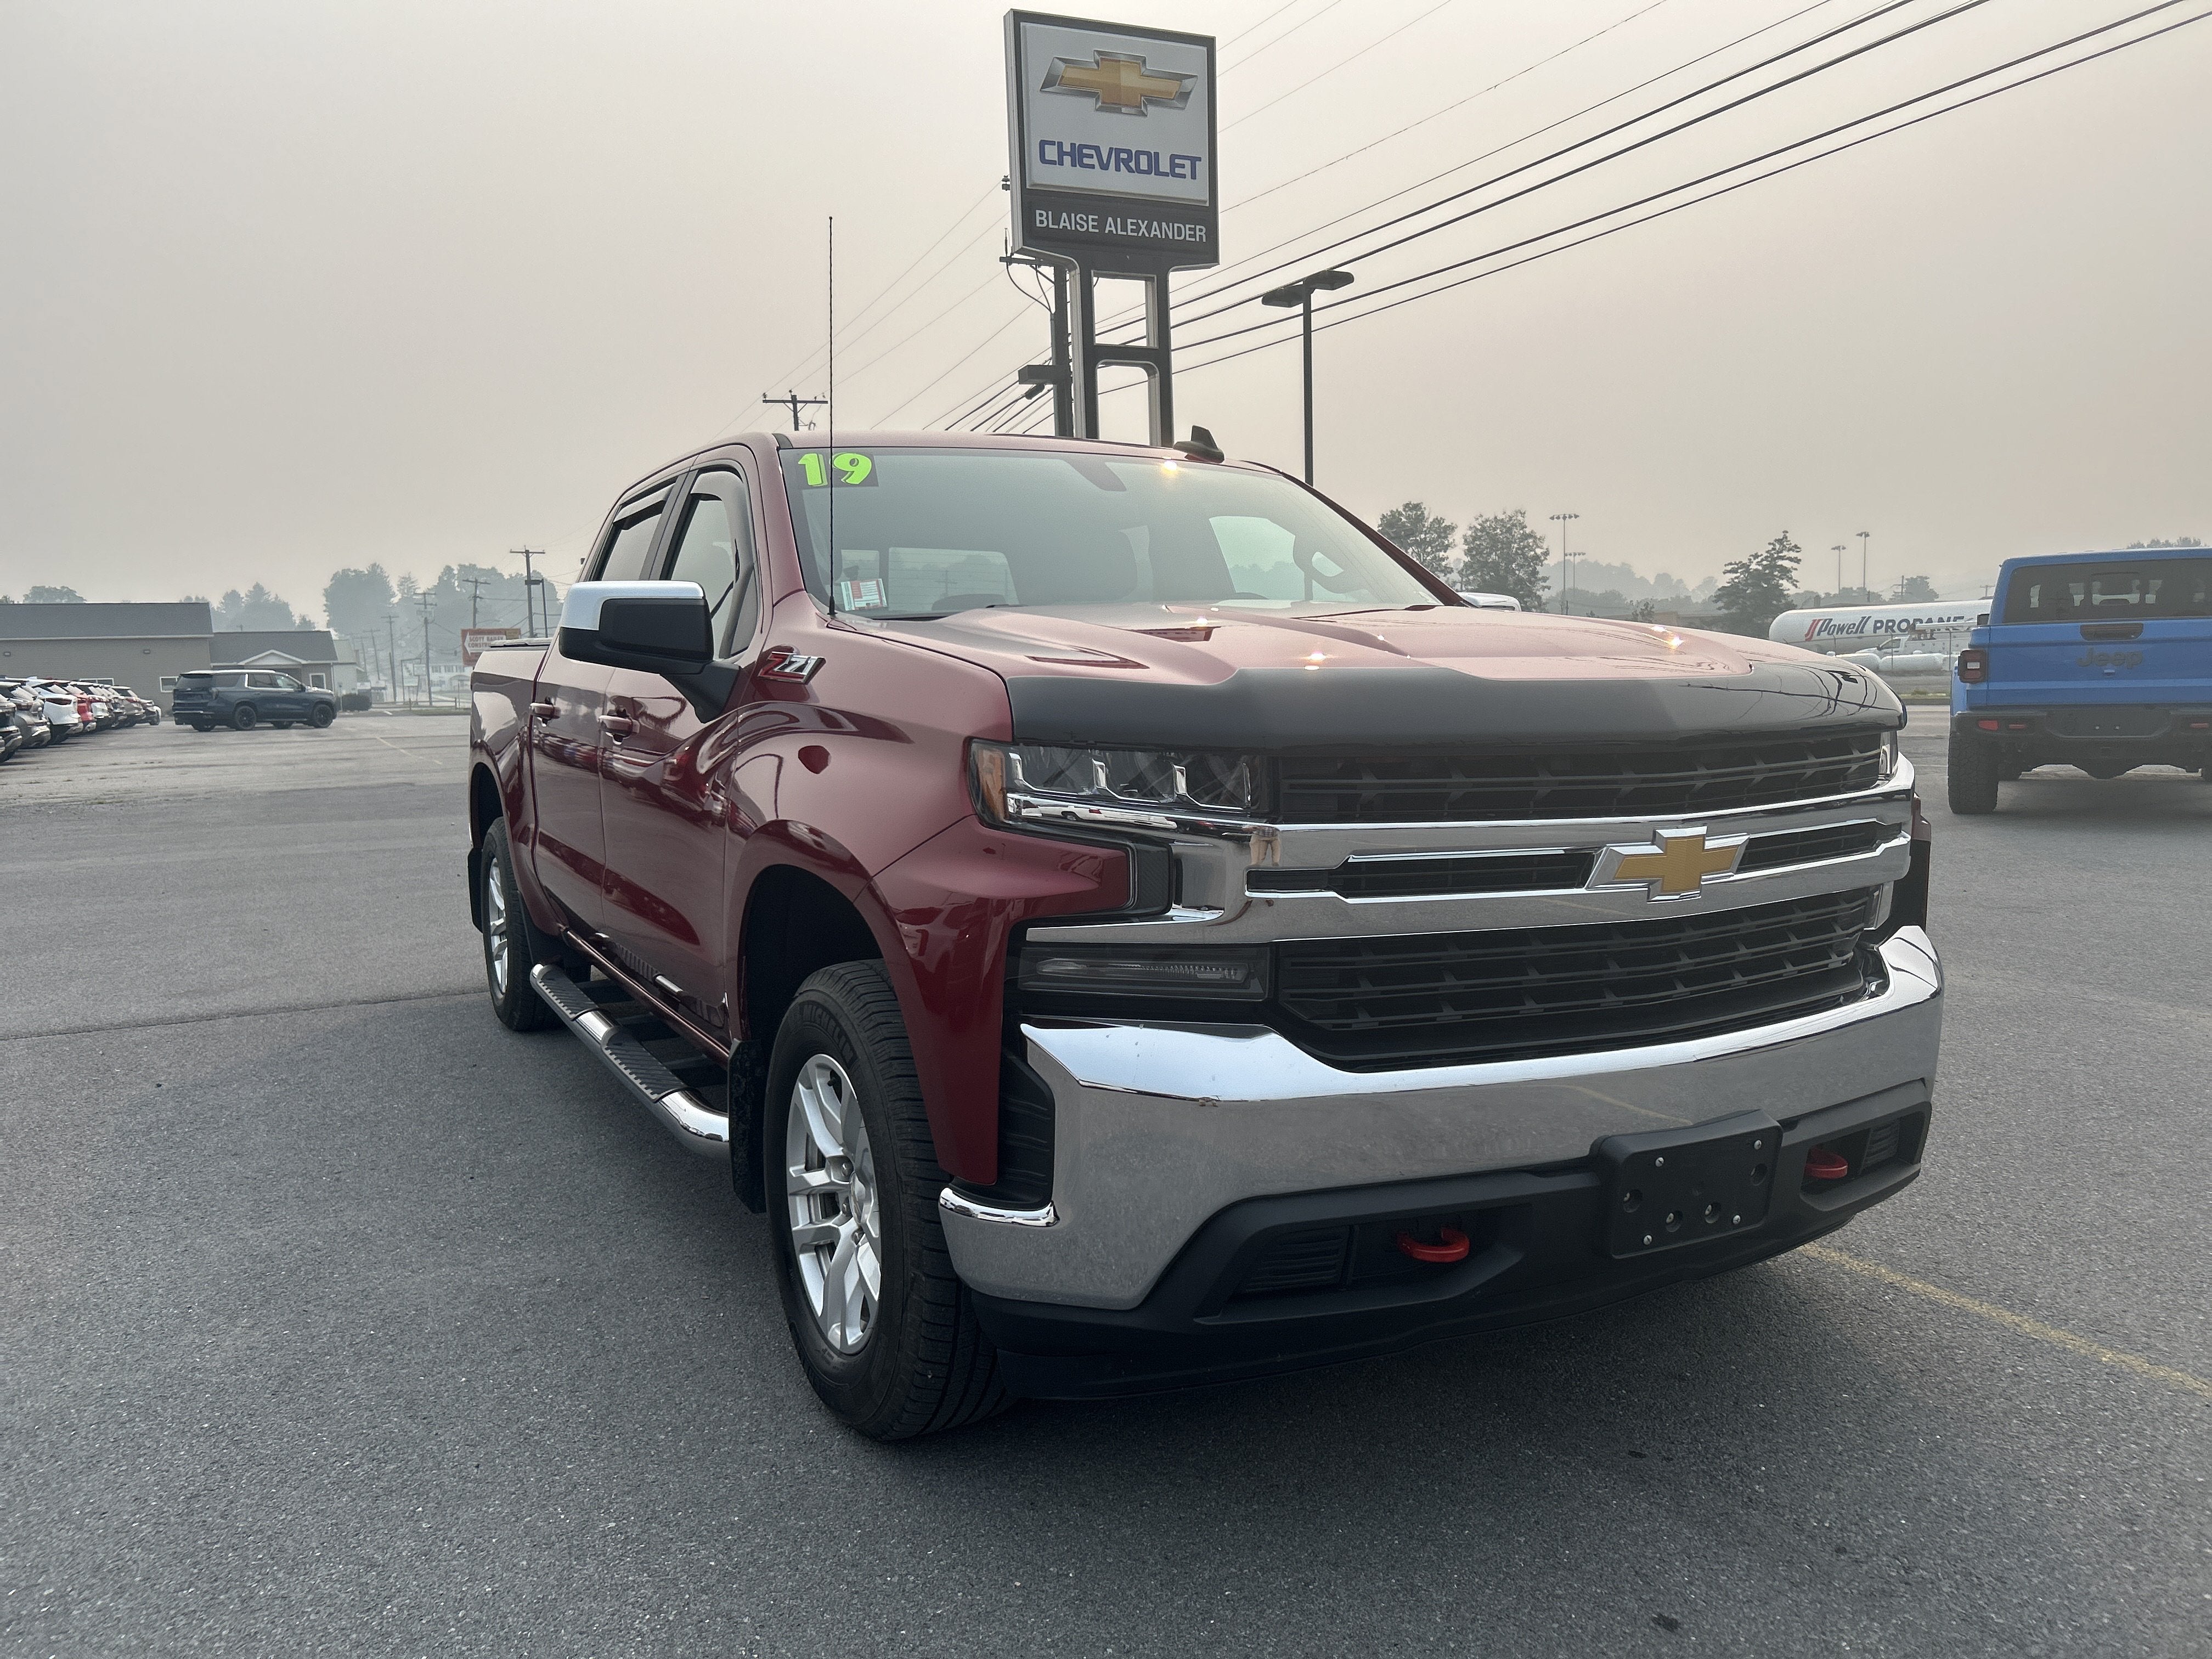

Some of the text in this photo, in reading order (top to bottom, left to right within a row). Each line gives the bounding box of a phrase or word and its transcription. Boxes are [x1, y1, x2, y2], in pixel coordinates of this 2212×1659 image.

[1039, 139, 1202, 179] CHEVROLET
[1035, 210, 1206, 242] BLAISE ALEXANDER
[798, 453, 872, 487] 19
[1816, 616, 1872, 636] Powell
[758, 651, 825, 684] Z71
[2075, 646, 2143, 669] Jeep
[802, 1003, 854, 1060] MICHELIN
